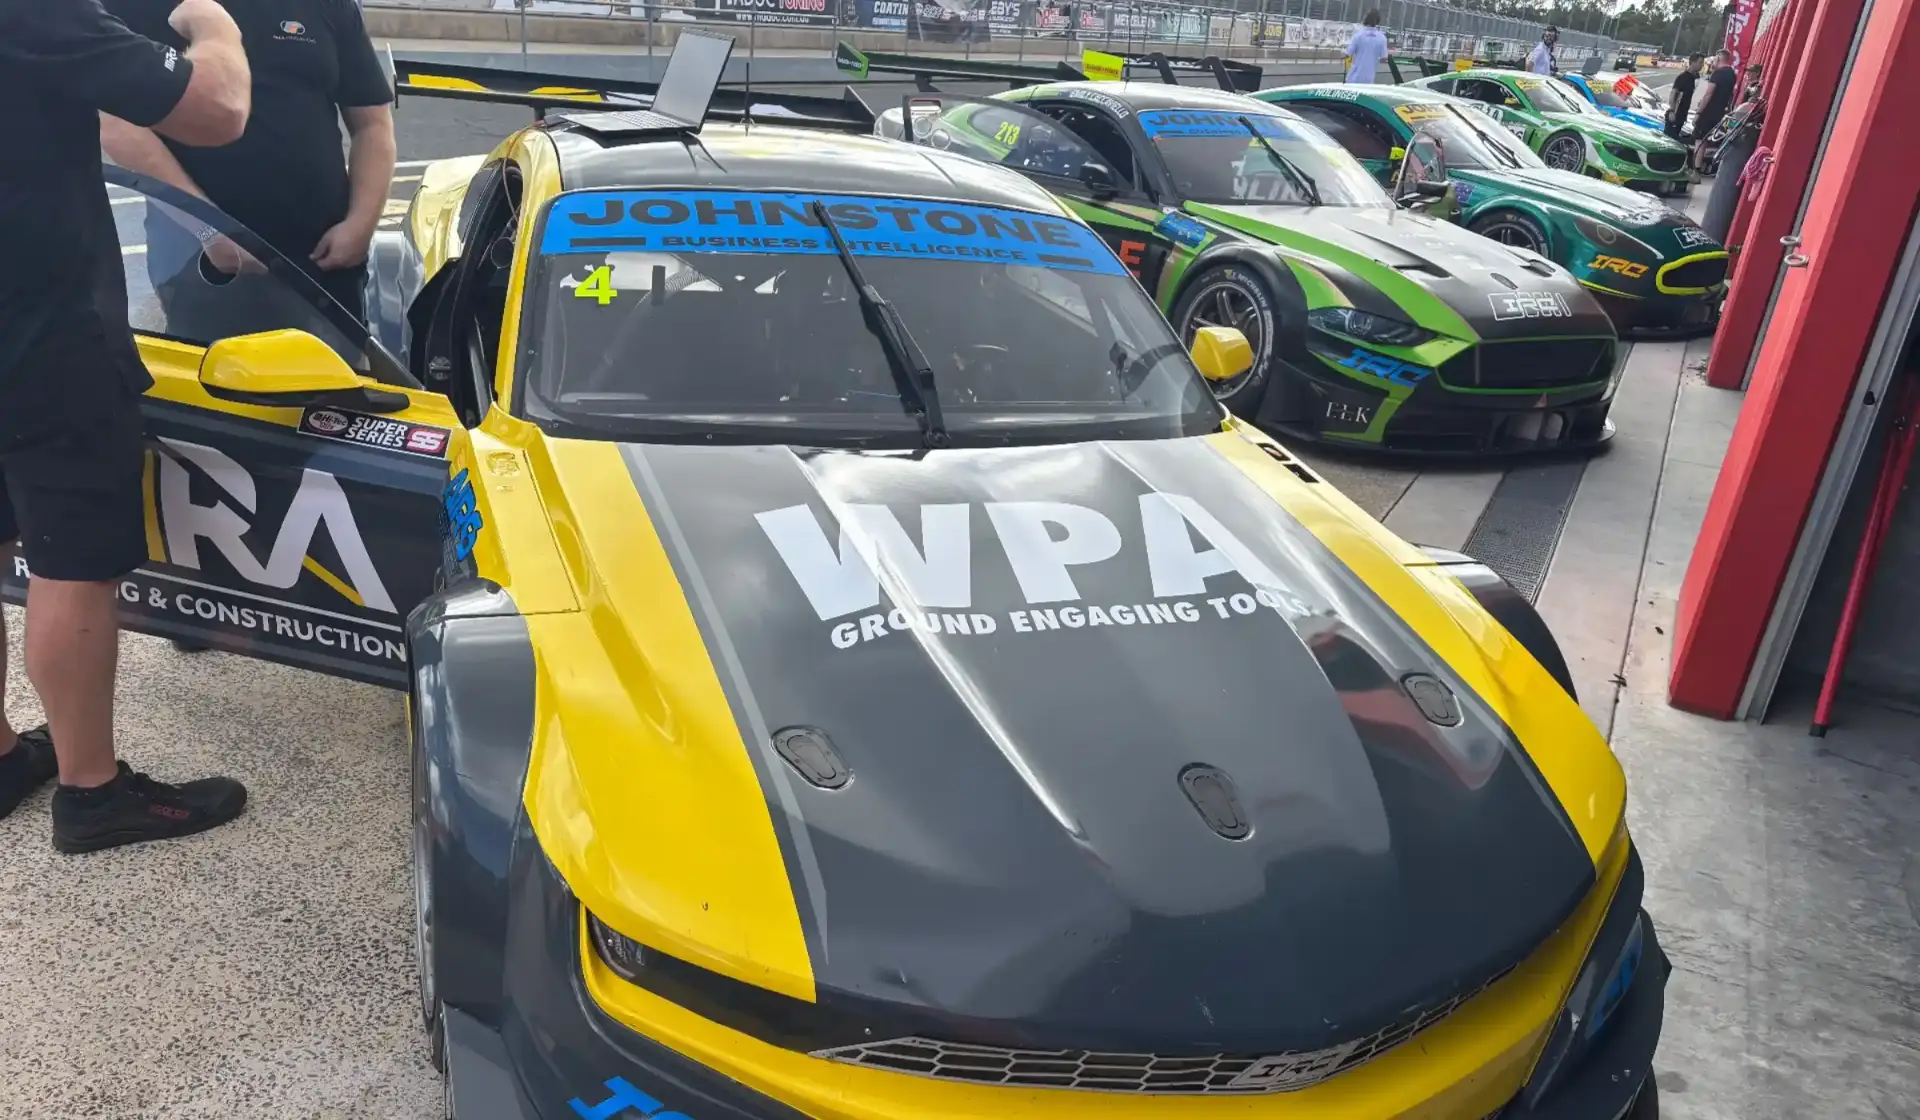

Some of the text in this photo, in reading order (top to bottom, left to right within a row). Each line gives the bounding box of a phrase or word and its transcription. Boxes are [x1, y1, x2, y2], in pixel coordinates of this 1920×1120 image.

[1314, 88, 1359, 101] HOLINGER
[994, 121, 1021, 146] 213
[569, 199, 1080, 248] JOHNSTONE
[662, 236, 819, 250] BUSINESS
[1588, 254, 1649, 279] IRC
[573, 265, 617, 305] 4
[1337, 348, 1432, 389] IRC
[344, 426, 406, 448] SERIES
[351, 416, 409, 436] SUPER
[753, 490, 1288, 621] WPA
[148, 587, 168, 609] &
[175, 594, 407, 663] CONSTRUCTION
[830, 606, 997, 649] GROUND
[1009, 602, 1200, 633] ENGAGING
